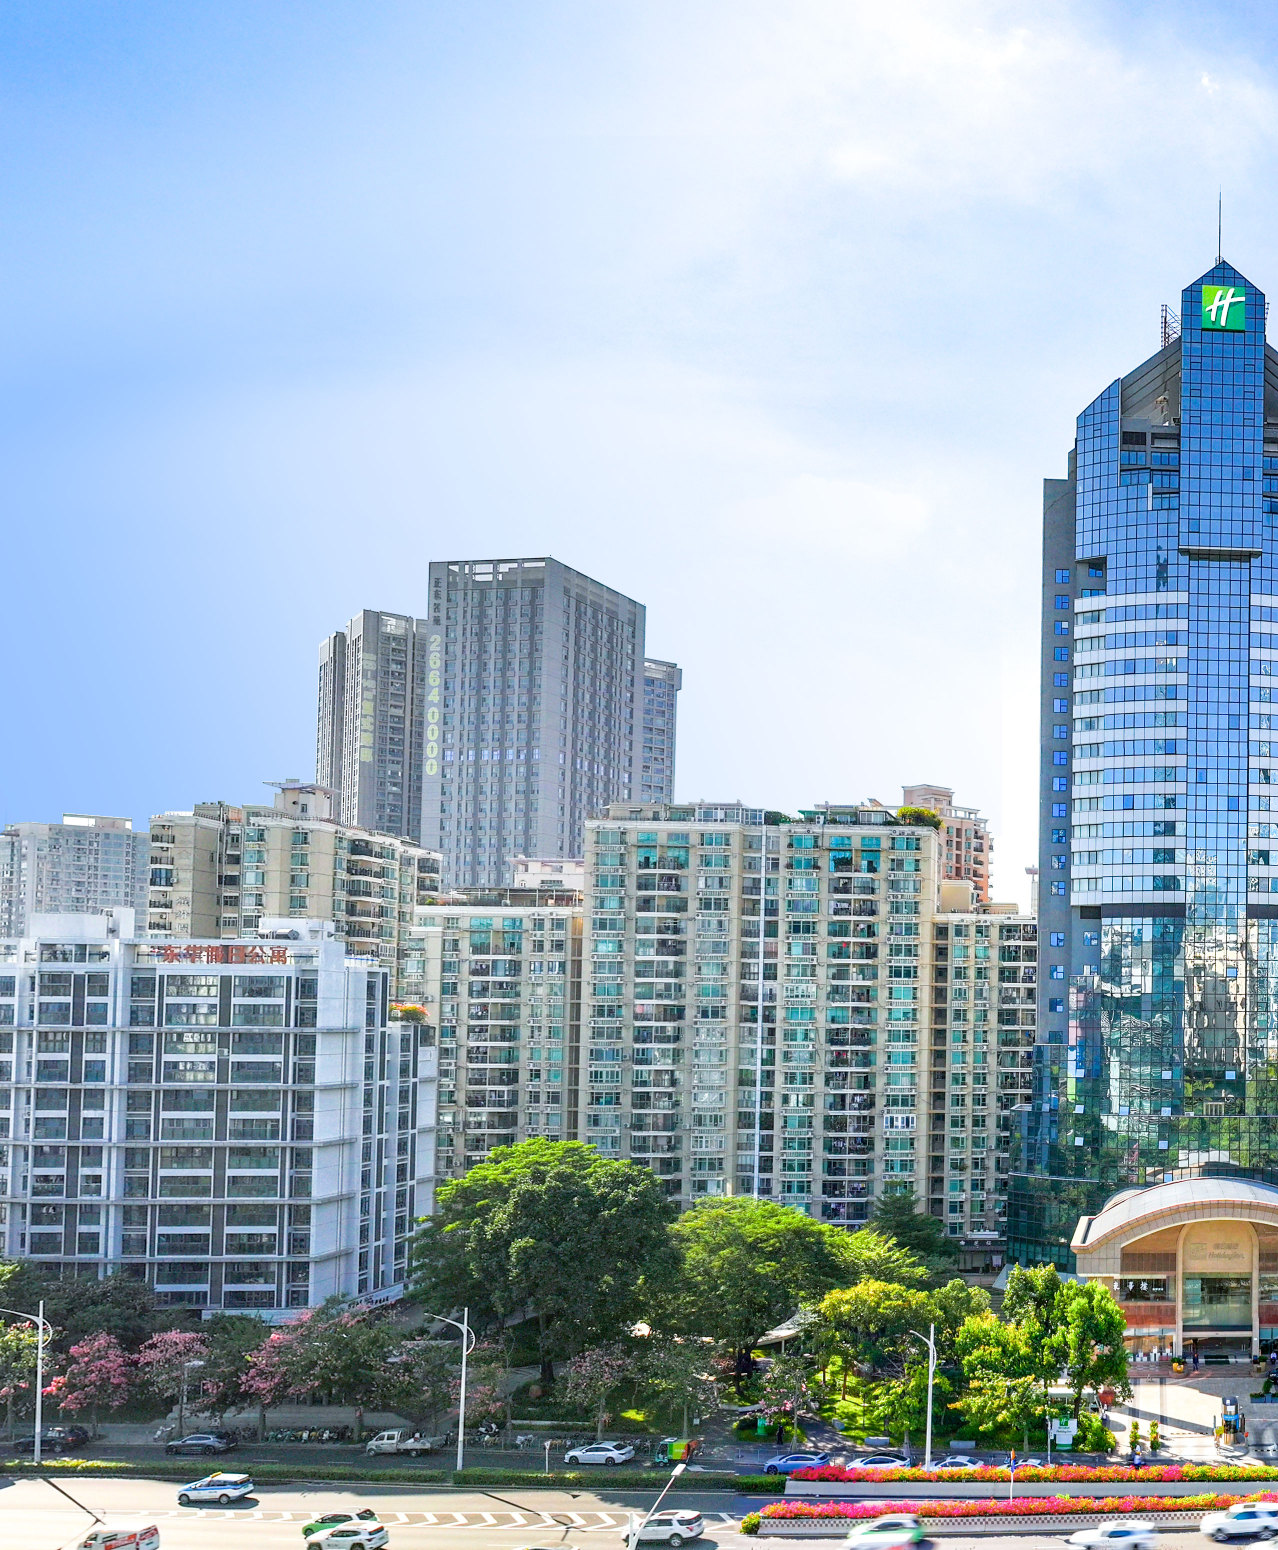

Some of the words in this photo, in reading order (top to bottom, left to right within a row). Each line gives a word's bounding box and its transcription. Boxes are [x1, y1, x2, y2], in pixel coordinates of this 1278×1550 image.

[162, 944, 289, 965] 东华假日公寓
